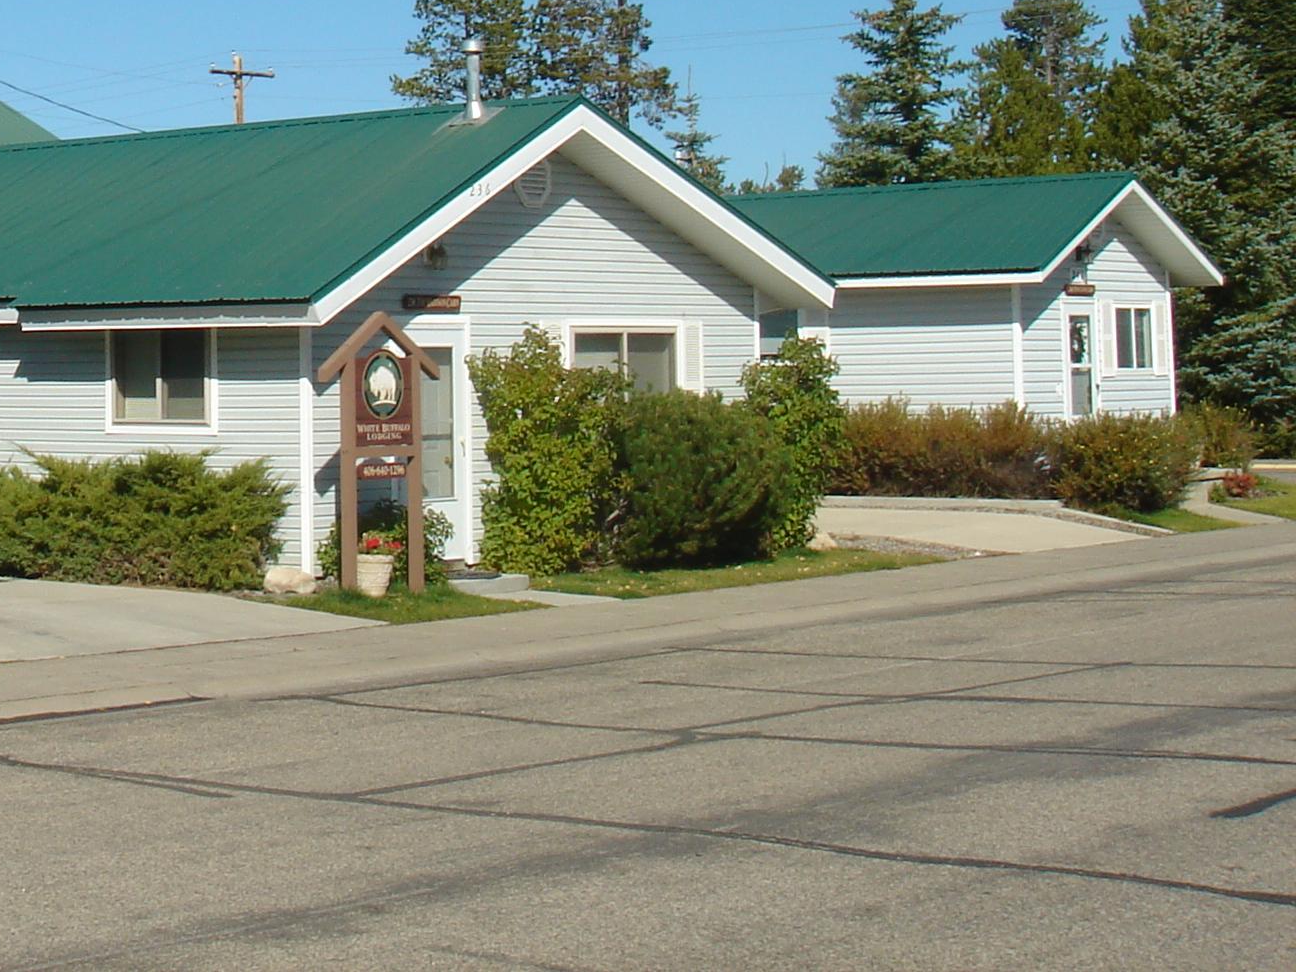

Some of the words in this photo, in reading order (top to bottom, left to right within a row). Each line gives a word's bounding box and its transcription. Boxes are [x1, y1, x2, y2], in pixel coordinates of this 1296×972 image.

[357, 424, 380, 433] WHITE
[381, 423, 410, 432] BUFFALO
[366, 432, 403, 441] LODGING
